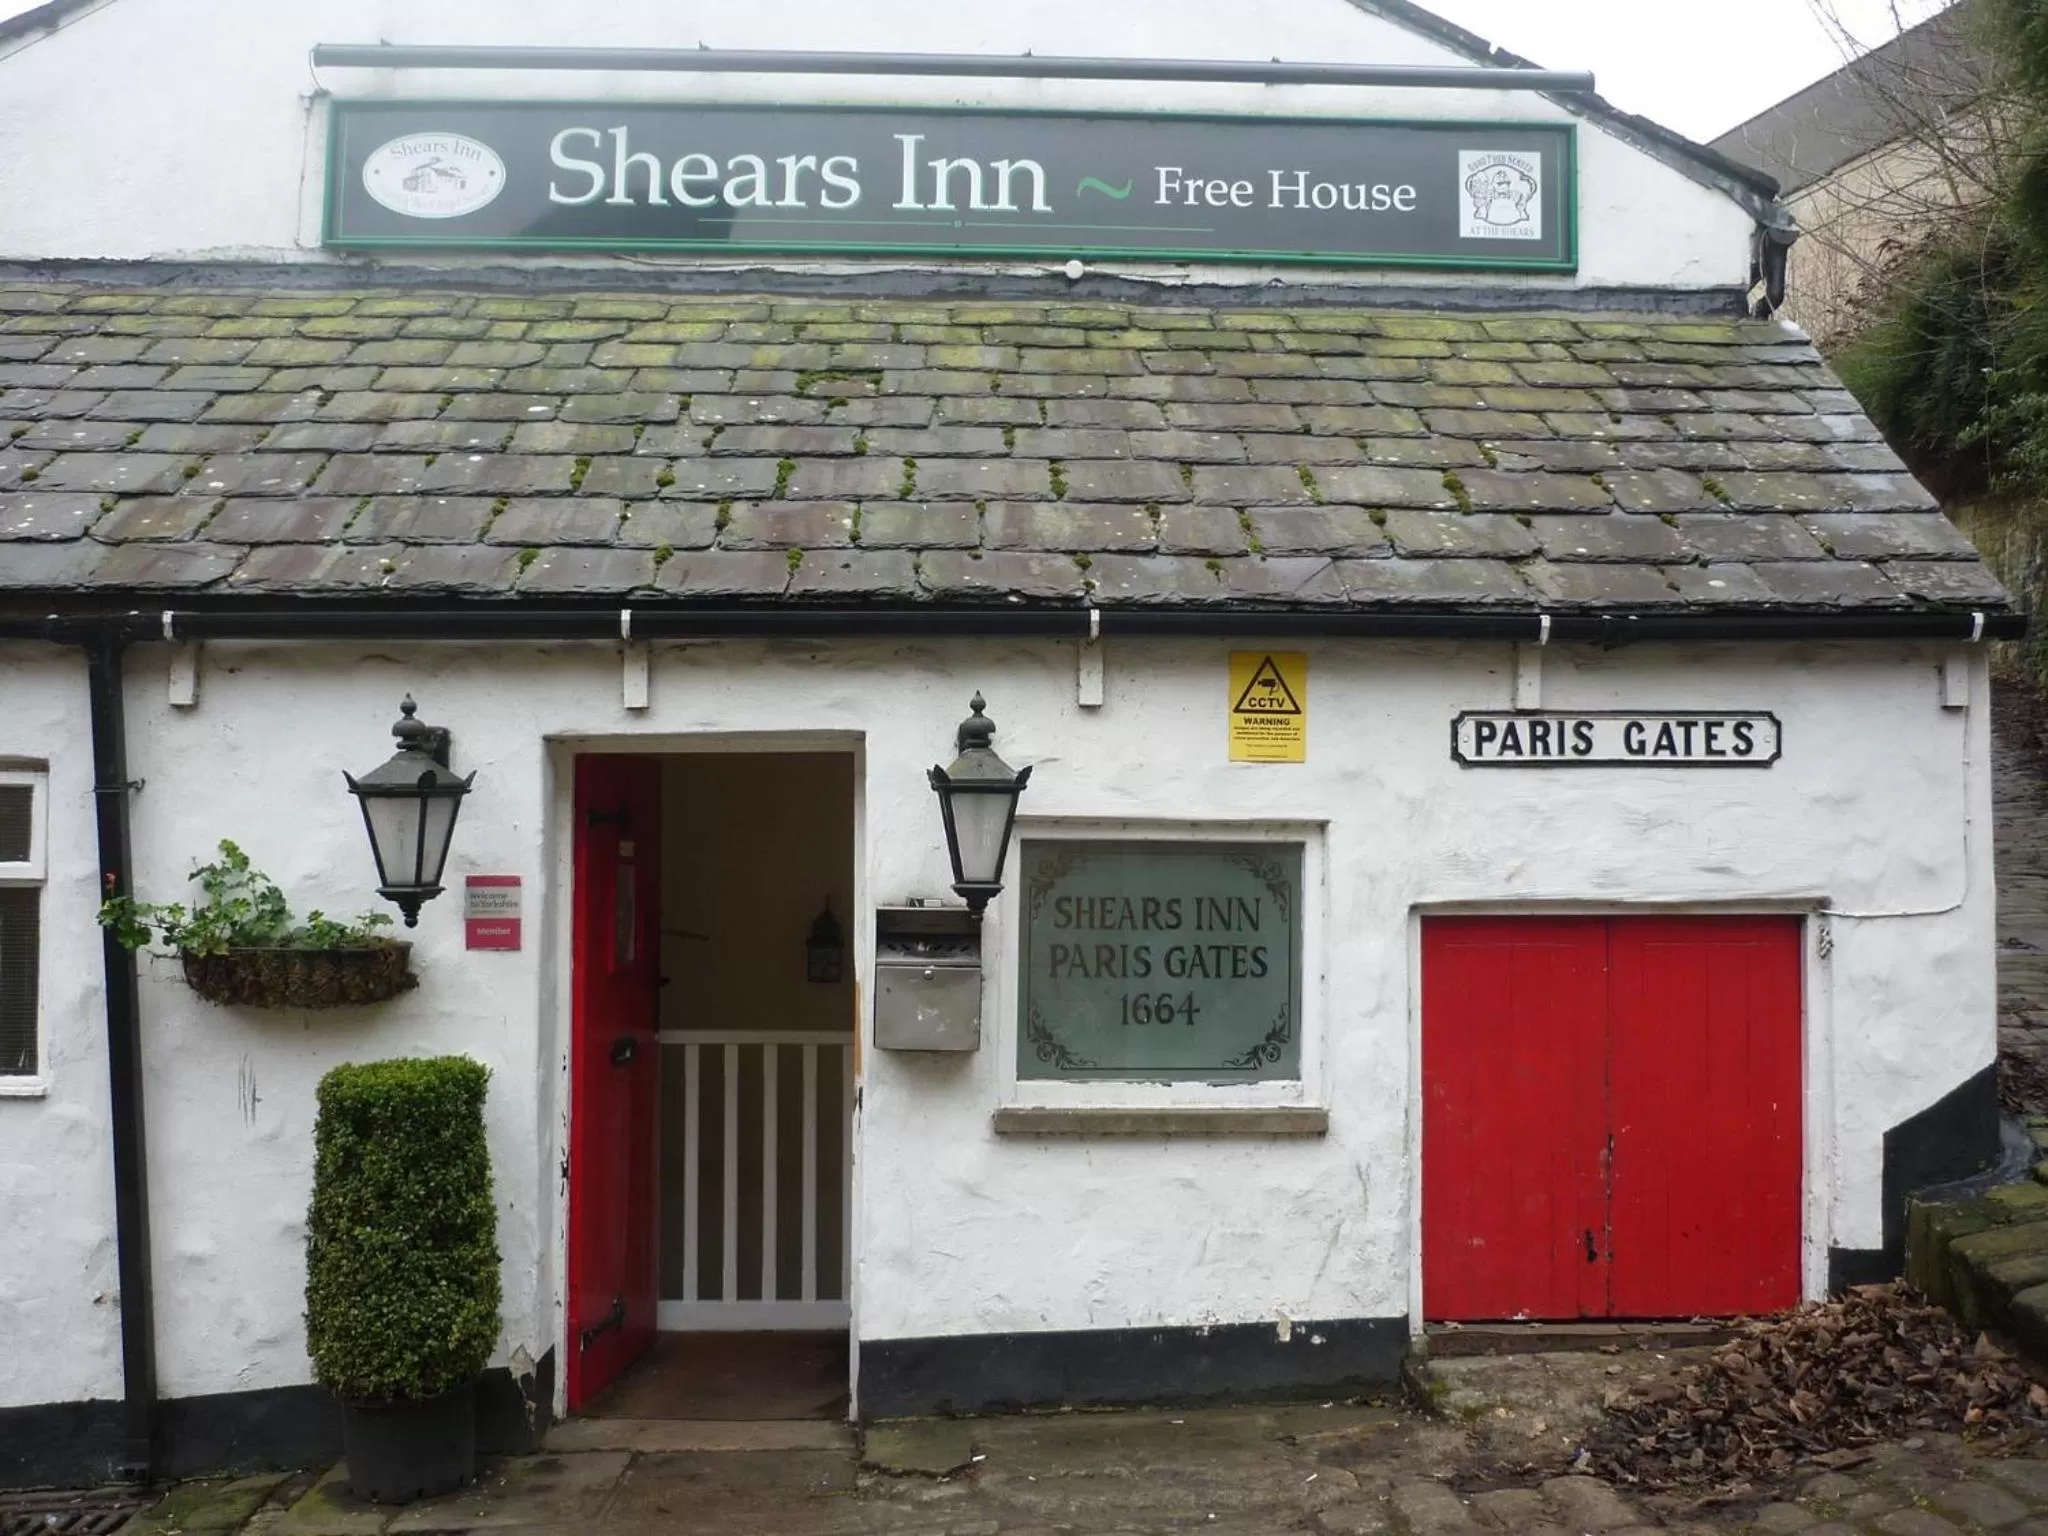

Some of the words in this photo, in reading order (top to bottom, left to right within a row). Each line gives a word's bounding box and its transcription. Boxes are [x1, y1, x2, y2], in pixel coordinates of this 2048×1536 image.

[390, 141, 448, 158] Shears
[548, 124, 862, 209] Shears
[891, 133, 1053, 213] Inn
[1154, 166, 1254, 207] Free
[1267, 169, 1417, 212] House
[1248, 697, 1286, 708] CCTV
[1243, 717, 1291, 726] WARNING
[1474, 720, 1594, 756] PARIS
[1623, 720, 1754, 756] GATES
[1053, 896, 1183, 932] SHEARS
[1195, 896, 1262, 932] INN
[1048, 944, 1152, 978] PARIS
[1163, 945, 1269, 979] GATES
[1120, 991, 1200, 1026] 1664
